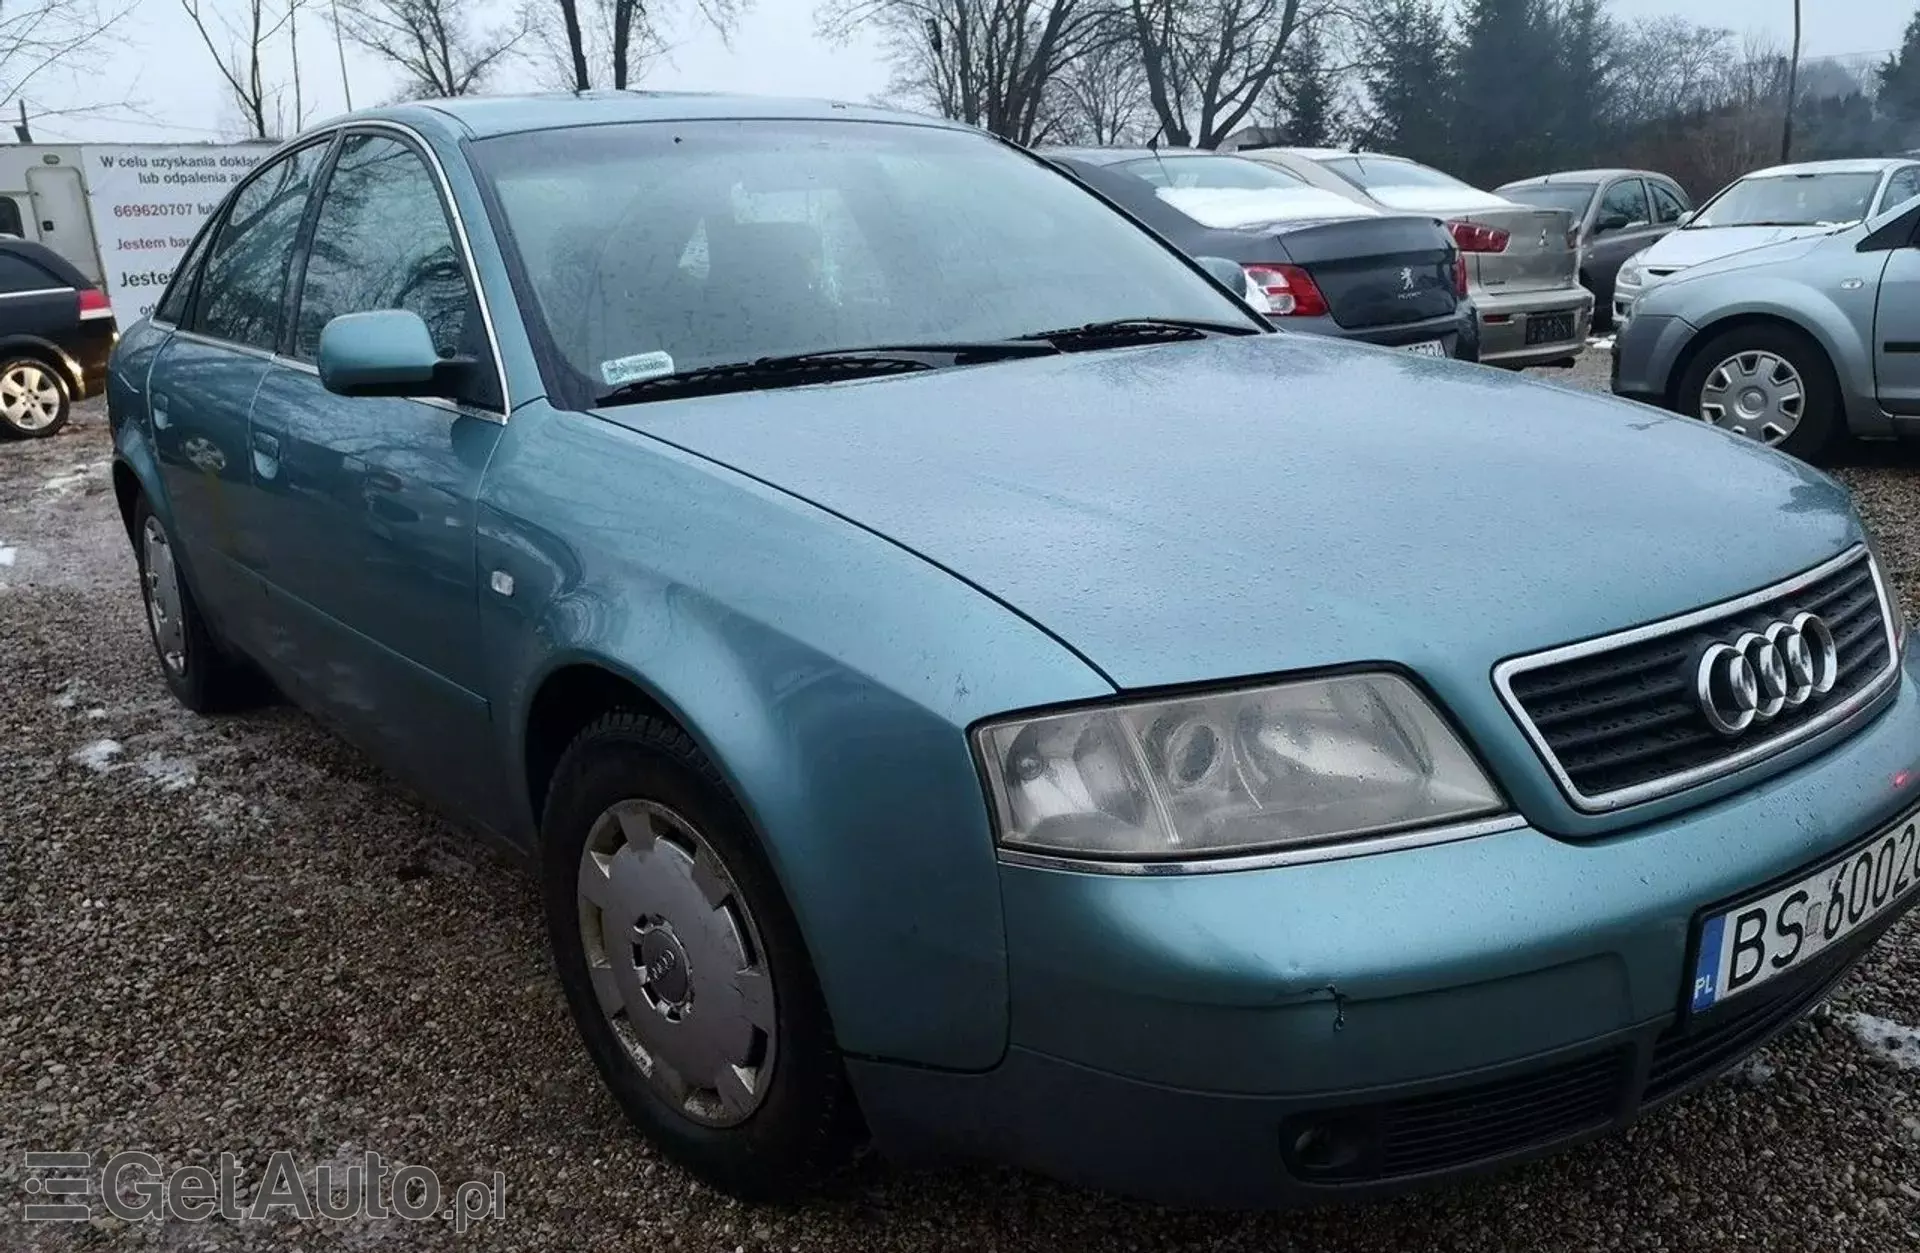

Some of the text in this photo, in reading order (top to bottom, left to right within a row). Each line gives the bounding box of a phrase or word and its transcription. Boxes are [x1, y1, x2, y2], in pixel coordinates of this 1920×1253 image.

[100, 156, 114, 168] W
[119, 155, 148, 168] celu
[151, 155, 216, 170] uzyskania
[138, 172, 159, 184] lub
[164, 172, 227, 186] odpalenia
[114, 203, 193, 218] 669620707
[117, 237, 167, 251] Jestem
[1727, 823, 1920, 991] BS 6002
[1694, 974, 1714, 999] PL
